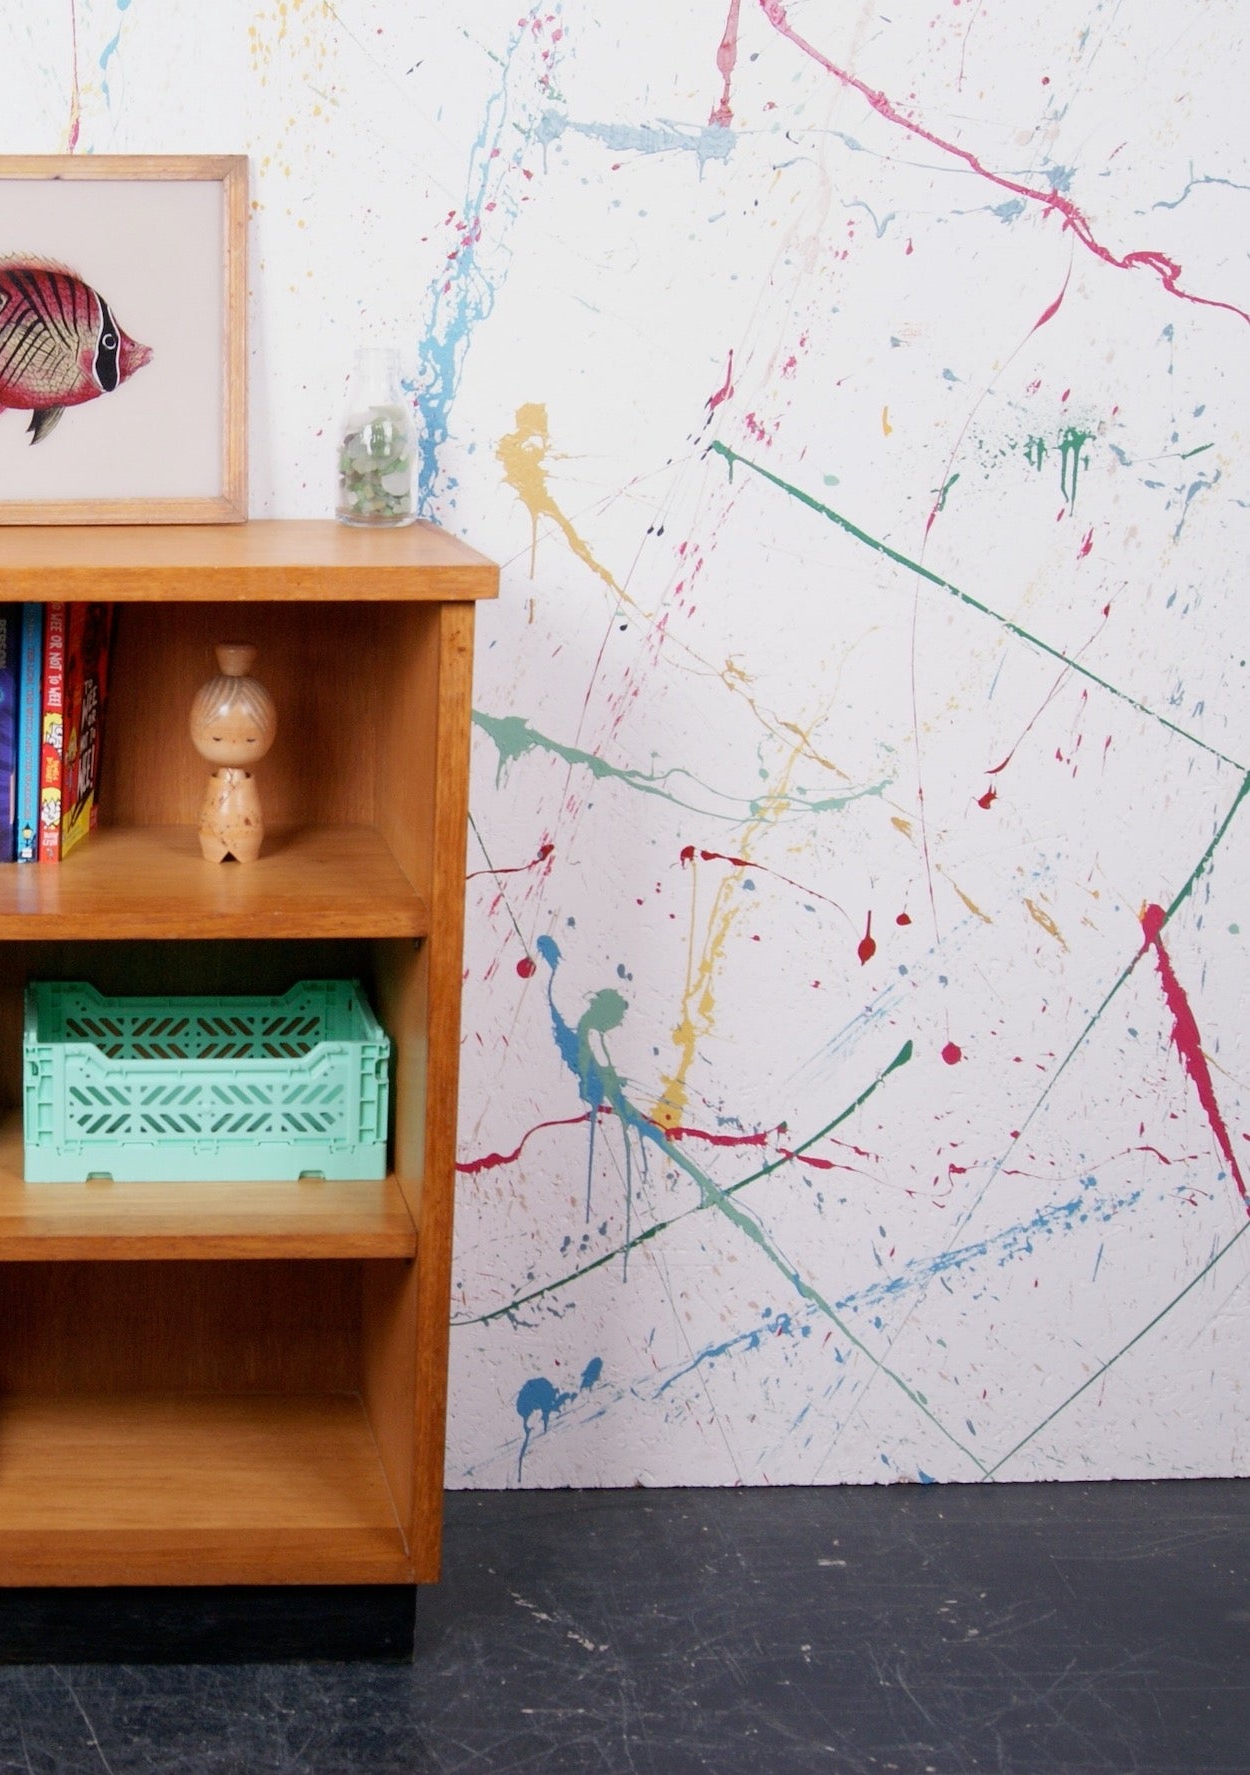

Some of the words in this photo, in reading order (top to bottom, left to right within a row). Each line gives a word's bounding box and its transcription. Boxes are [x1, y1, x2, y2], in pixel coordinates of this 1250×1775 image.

[50, 612, 62, 632] WEE
[49, 635, 63, 649] OR
[48, 652, 62, 671] NOT
[48, 673, 62, 685] TO
[46, 687, 62, 707] WEE!
